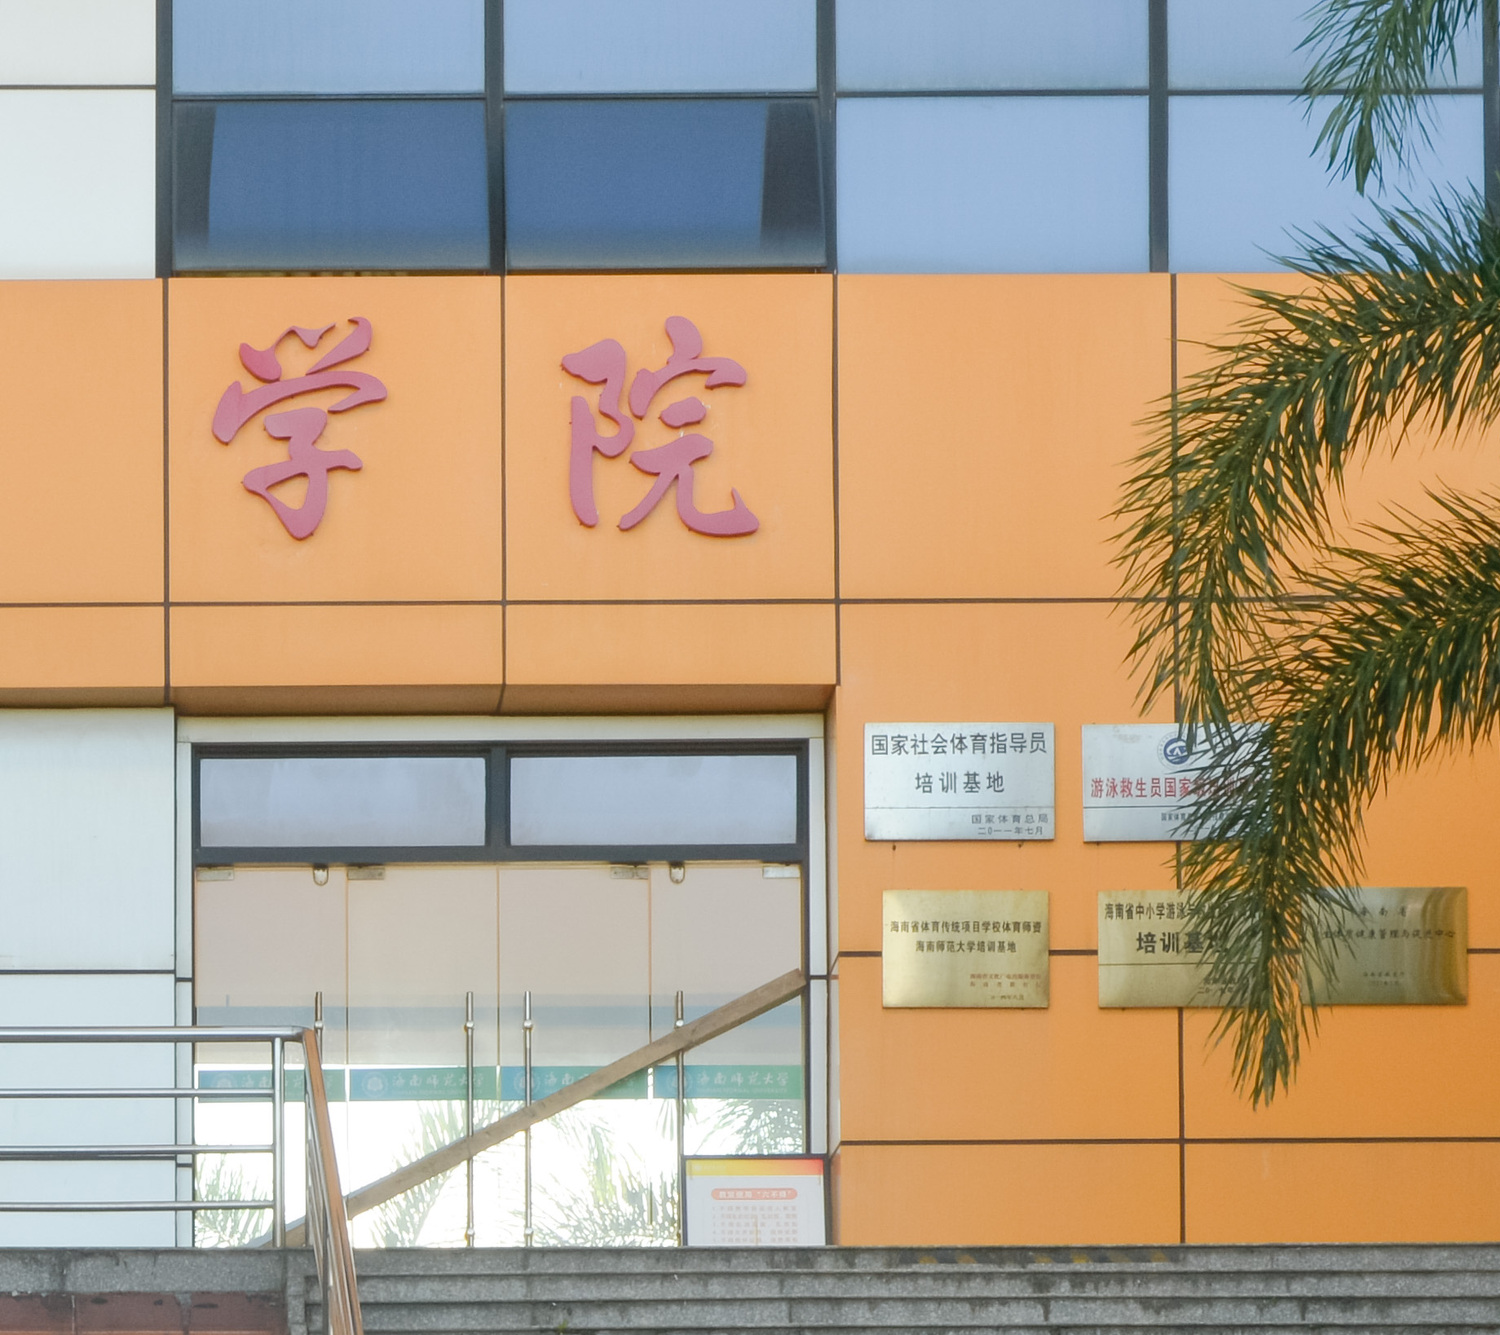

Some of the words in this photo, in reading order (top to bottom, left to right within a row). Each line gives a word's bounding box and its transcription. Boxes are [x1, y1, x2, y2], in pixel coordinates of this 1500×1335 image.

[871, 732, 1047, 755] 国家社会体育指导员
[914, 771, 1005, 793] 培训基地
[971, 814, 1048, 824] 国家体育总局
[890, 921, 1042, 933] 海南省体育传统项目学校体育师资
[915, 941, 1017, 953] 海南师范大学培训基地
[1136, 932, 1222, 954] 培训基
[696, 1069, 789, 1087] 海南师范大学
